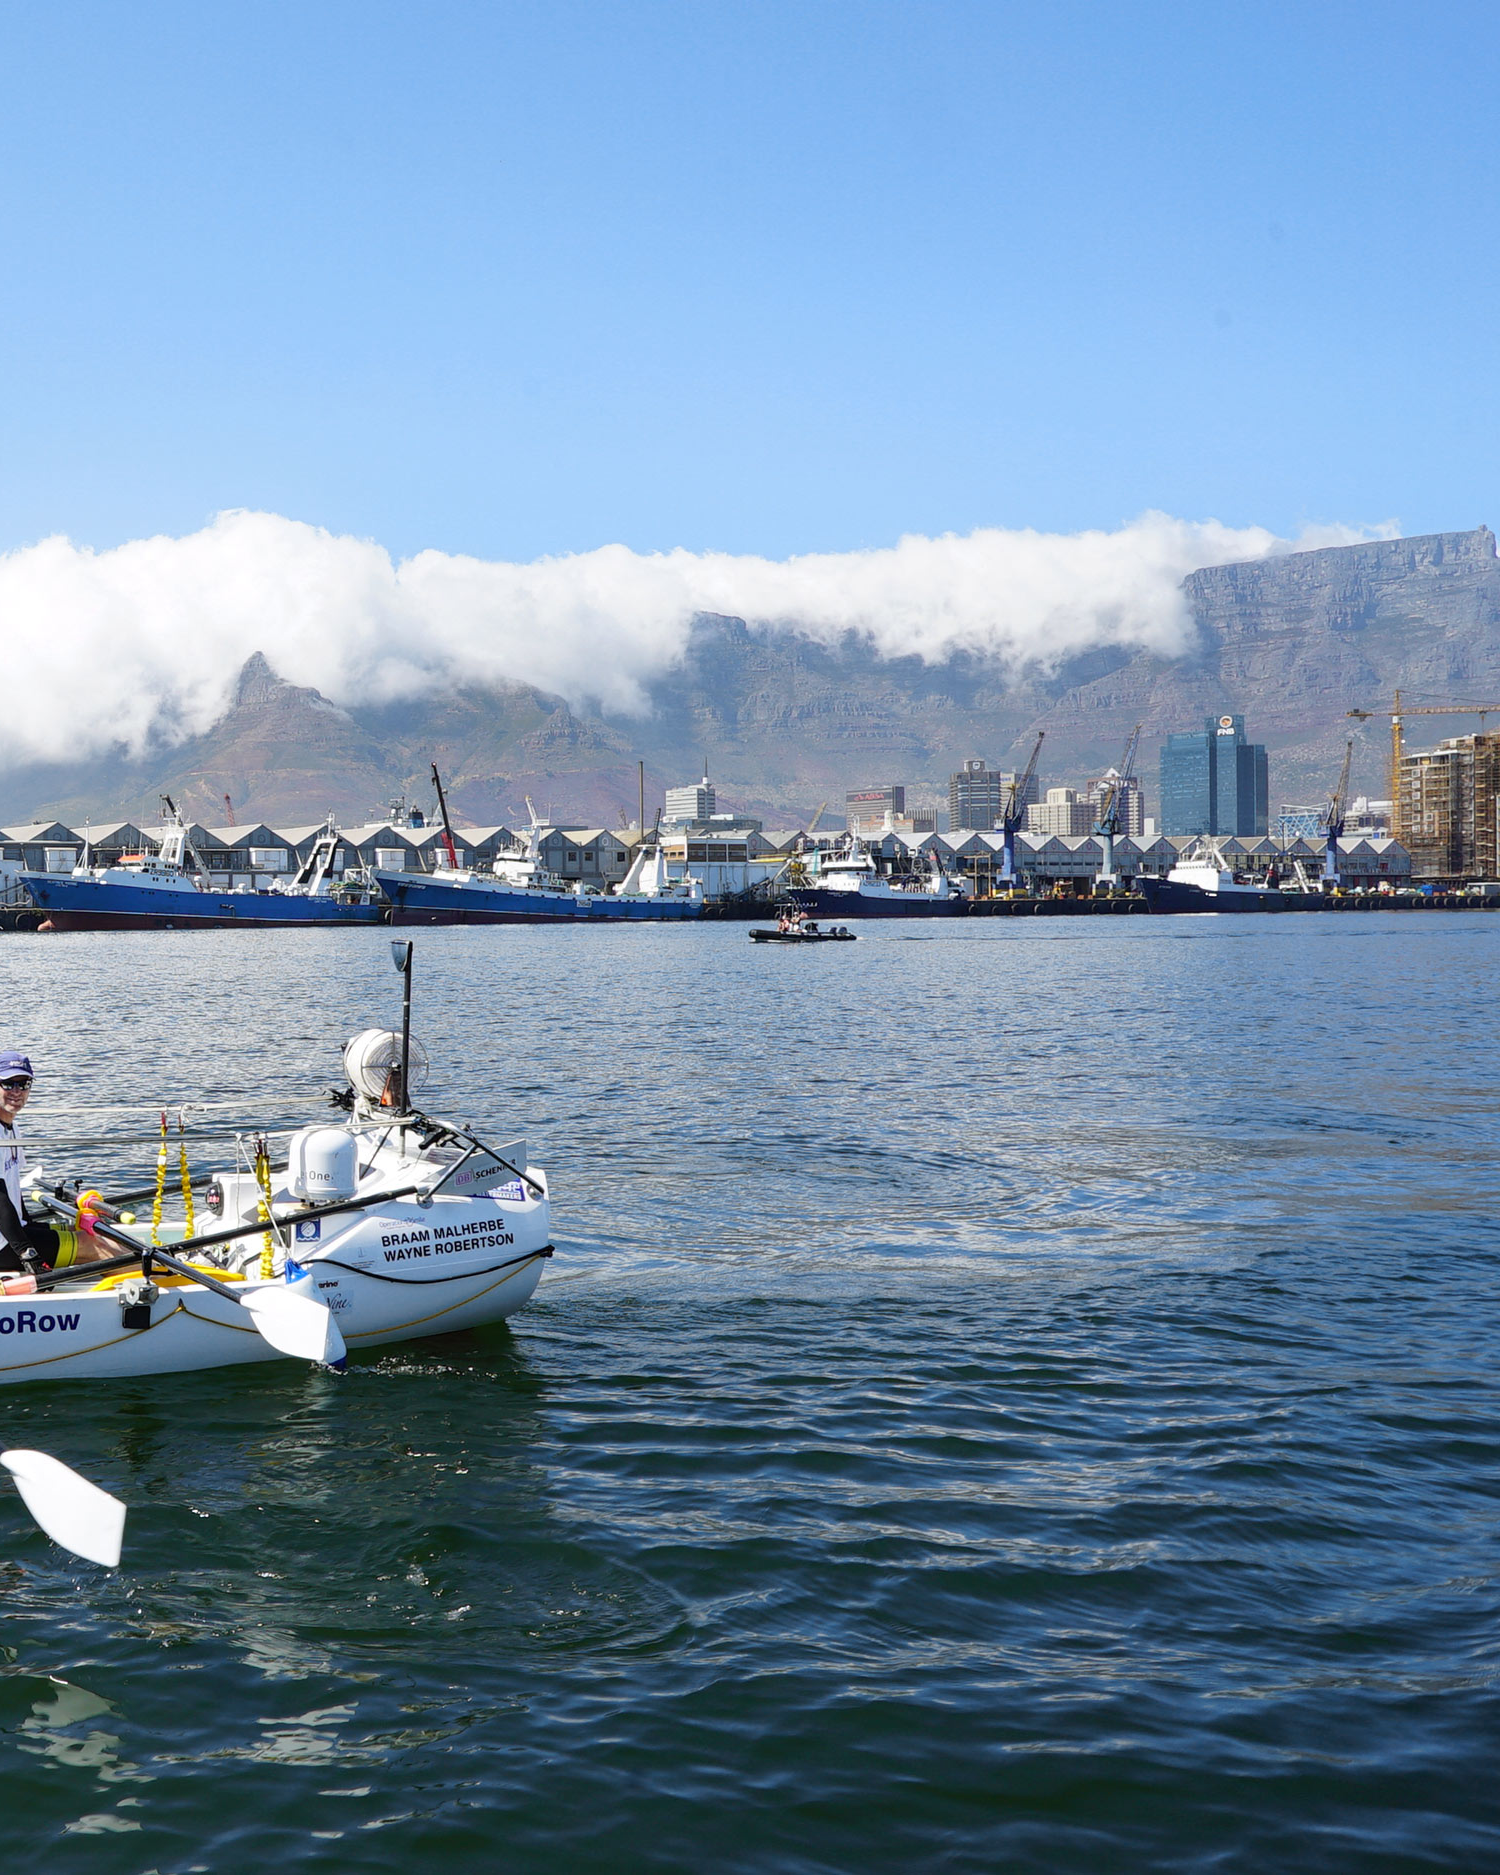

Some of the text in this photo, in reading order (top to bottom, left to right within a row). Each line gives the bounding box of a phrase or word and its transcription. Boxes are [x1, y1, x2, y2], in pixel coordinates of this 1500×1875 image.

[1217, 727, 1235, 736] FNB
[457, 1173, 471, 1182] DB
[475, 1159, 516, 1180] SCHENR
[381, 1218, 505, 1247] BRAAM MALHERBE
[383, 1233, 514, 1262] WAYNE ROBERTSON
